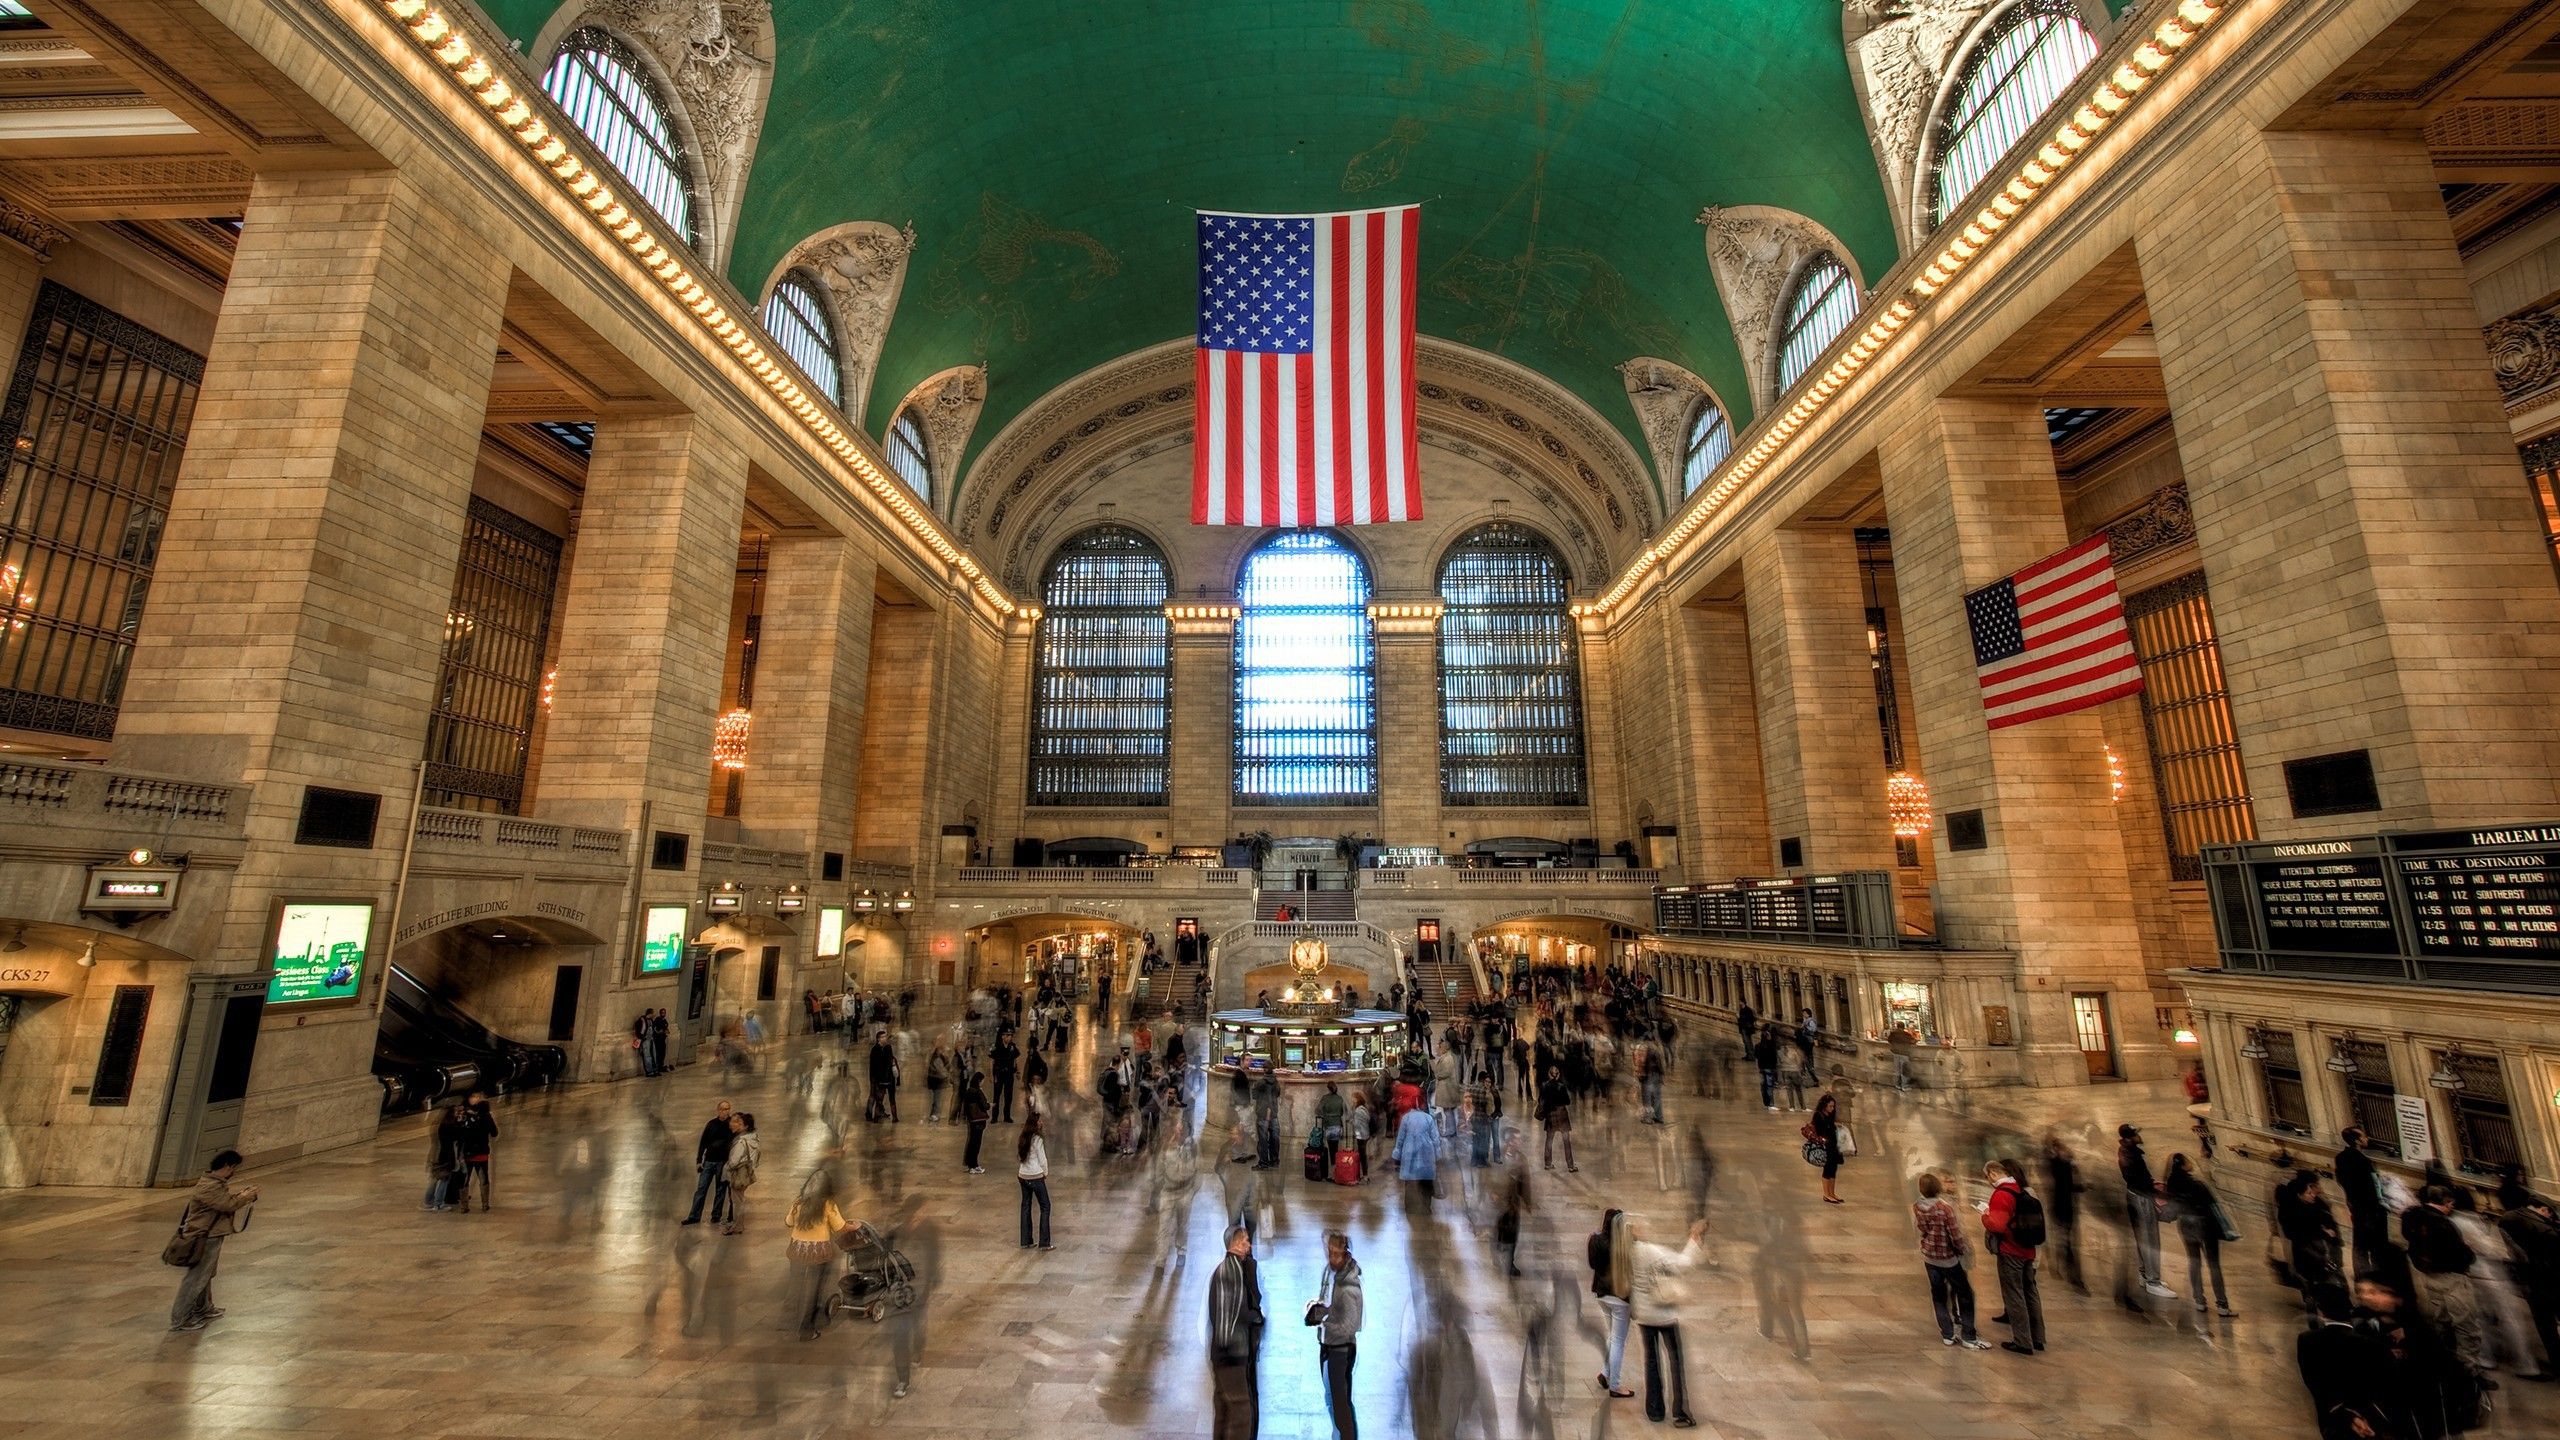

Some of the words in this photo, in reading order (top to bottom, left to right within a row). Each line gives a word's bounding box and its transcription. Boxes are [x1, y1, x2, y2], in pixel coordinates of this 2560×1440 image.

[2472, 829, 2540, 844] HARLEM
[2274, 842, 2352, 856] INFORMATION
[2403, 860, 2430, 871] TIME
[2436, 859, 2460, 870] TRK
[2465, 855, 2546, 869] DESTINATION
[2280, 866, 2315, 876] ATTENTION
[2338, 878, 2383, 888] UNATTENDED
[2509, 872, 2545, 883] PLAINS
[2303, 893, 2324, 902] ITEMS
[2325, 892, 2339, 901] MAY
[2342, 892, 2352, 901] BE
[2354, 891, 2386, 901] REMOVED
[2475, 889, 2526, 900] SOUTHEAST
[536, 901, 557, 915] 45TH
[557, 905, 586, 924] STREET
[1065, 905, 1105, 917] LEXINGTON
[1494, 907, 1535, 922] LEXINGTON
[1573, 907, 1597, 915] TICKET
[1599, 909, 1635, 924] MACHINES
[2281, 906, 2294, 915] THE
[2310, 906, 2334, 915] POLICE
[2517, 905, 2554, 916] PLAINS
[395, 928, 416, 945] THE
[417, 907, 463, 934] METLIFE
[464, 899, 509, 918] BUILDING
[2521, 921, 2558, 932] PLAINS
[2487, 936, 2539, 947] SOUTHEAST
[33, 970, 51, 982] 27
